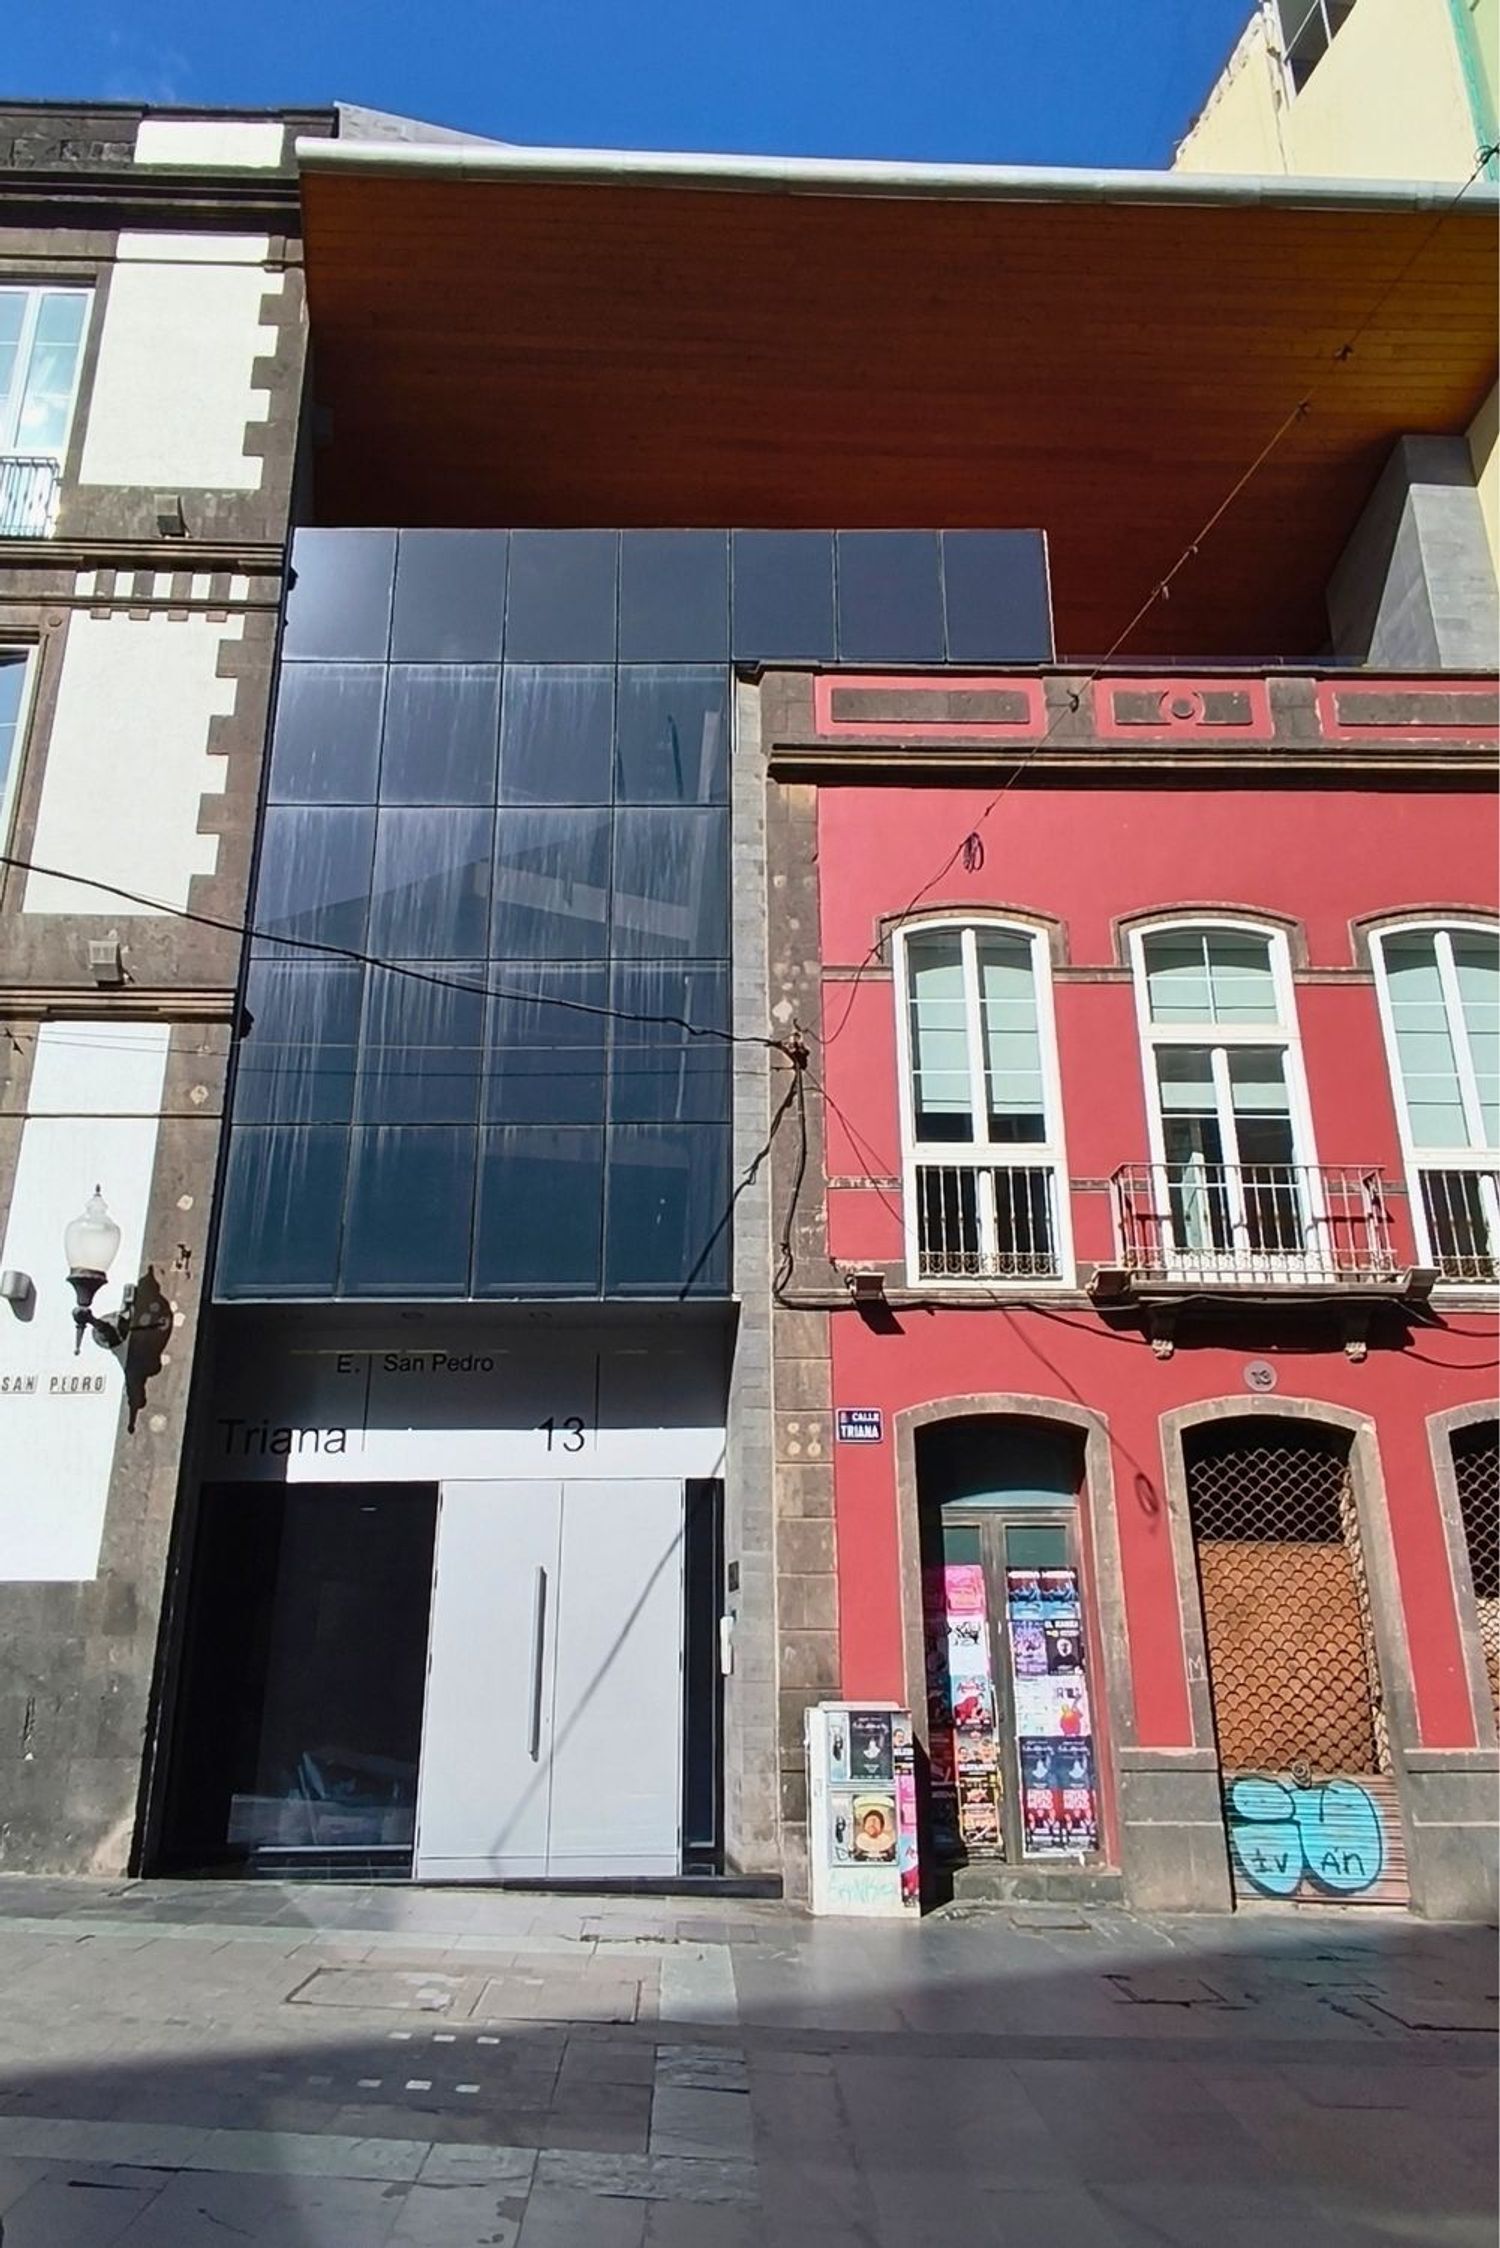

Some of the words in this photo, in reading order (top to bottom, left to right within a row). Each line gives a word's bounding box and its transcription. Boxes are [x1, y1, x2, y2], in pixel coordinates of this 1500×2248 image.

[337, 1354, 360, 1374] E.
[384, 1354, 425, 1372] San
[431, 1354, 495, 1372] Pedro
[1, 1376, 35, 1392] SAN
[49, 1376, 104, 1392] PEDRO
[217, 1418, 348, 1455] Triana
[537, 1416, 585, 1452] 13
[840, 1424, 880, 1439] TRIANA
